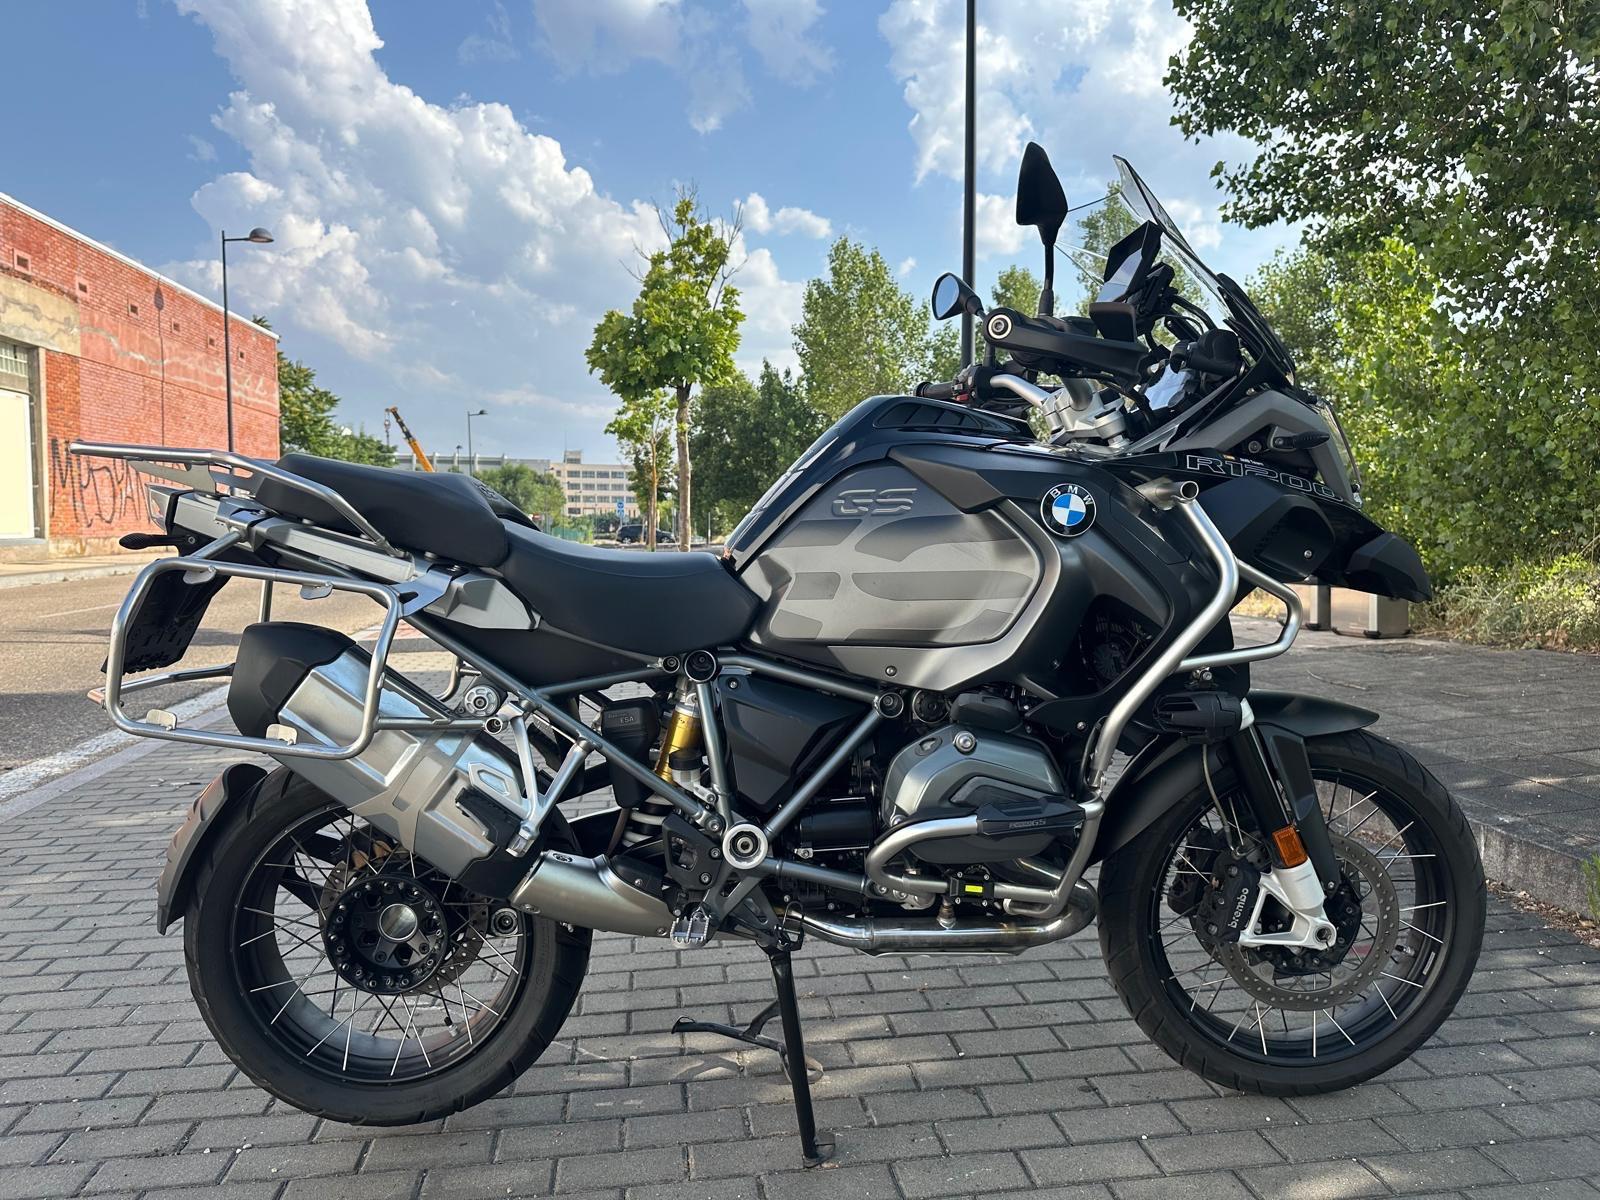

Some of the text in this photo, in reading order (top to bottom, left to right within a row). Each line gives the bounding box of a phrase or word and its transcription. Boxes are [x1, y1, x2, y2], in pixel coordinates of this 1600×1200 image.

[832, 488, 917, 517] GS
[1049, 485, 1094, 505] BMW
[1227, 887, 1249, 929] brembo
